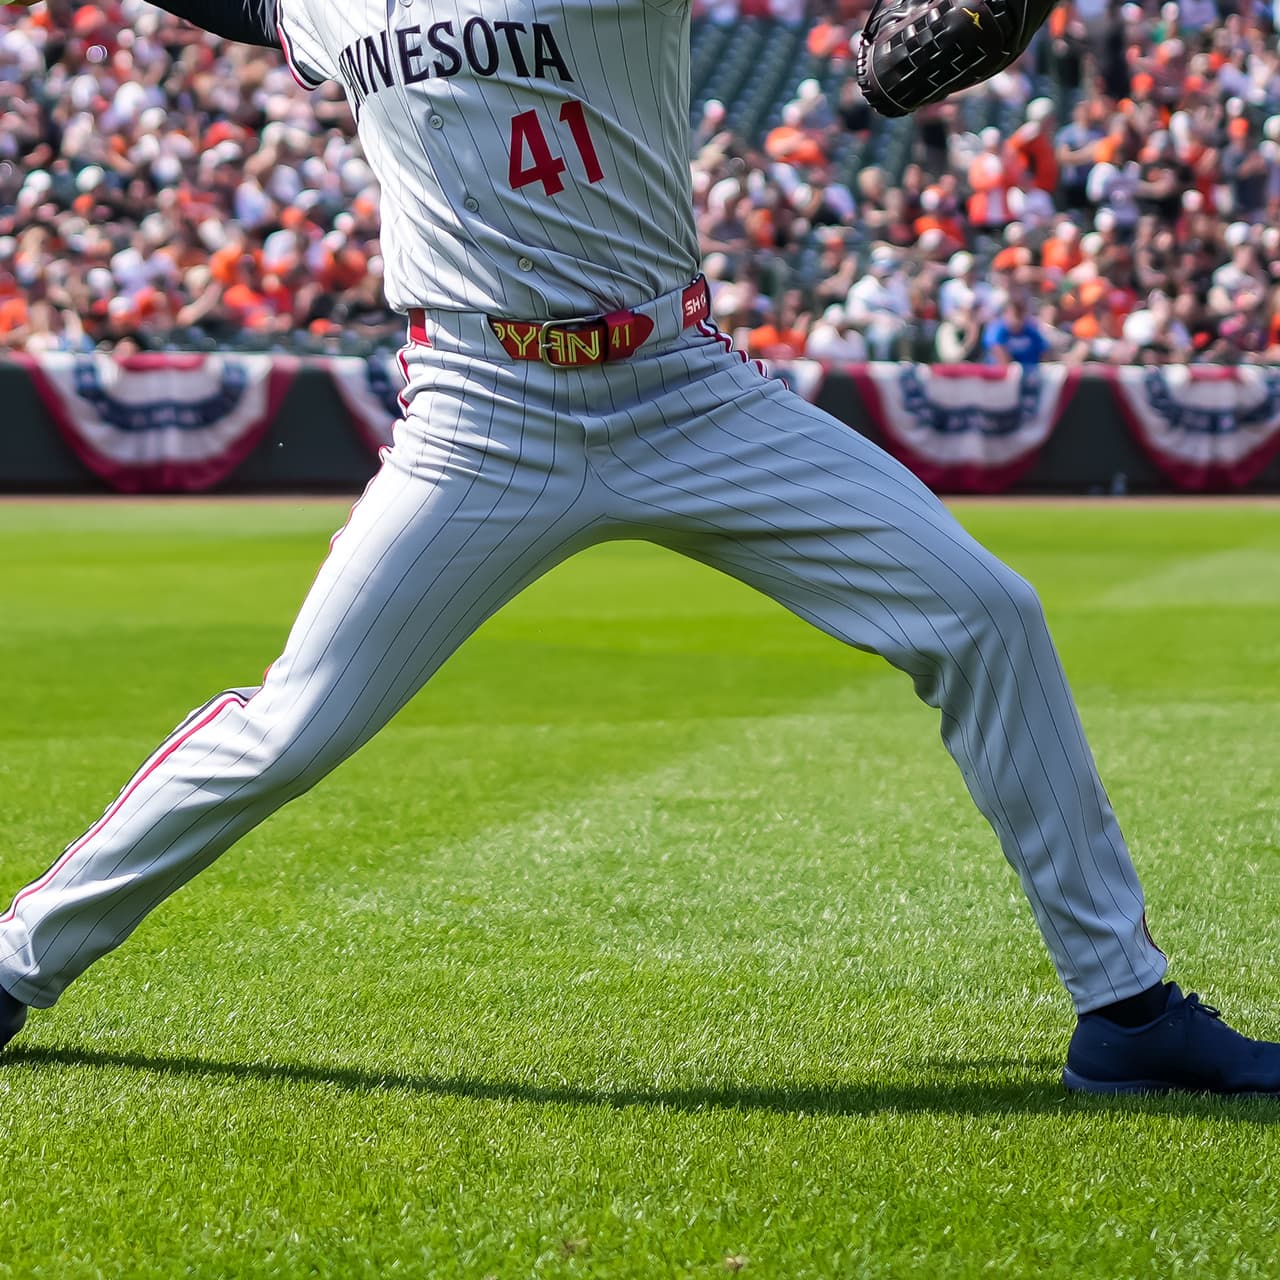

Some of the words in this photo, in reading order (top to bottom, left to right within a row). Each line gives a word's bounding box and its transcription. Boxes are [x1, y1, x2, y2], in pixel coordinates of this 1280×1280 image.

[338, 16, 574, 123] NNESOTA
[508, 100, 605, 196] 41
[611, 324, 631, 349] 41
